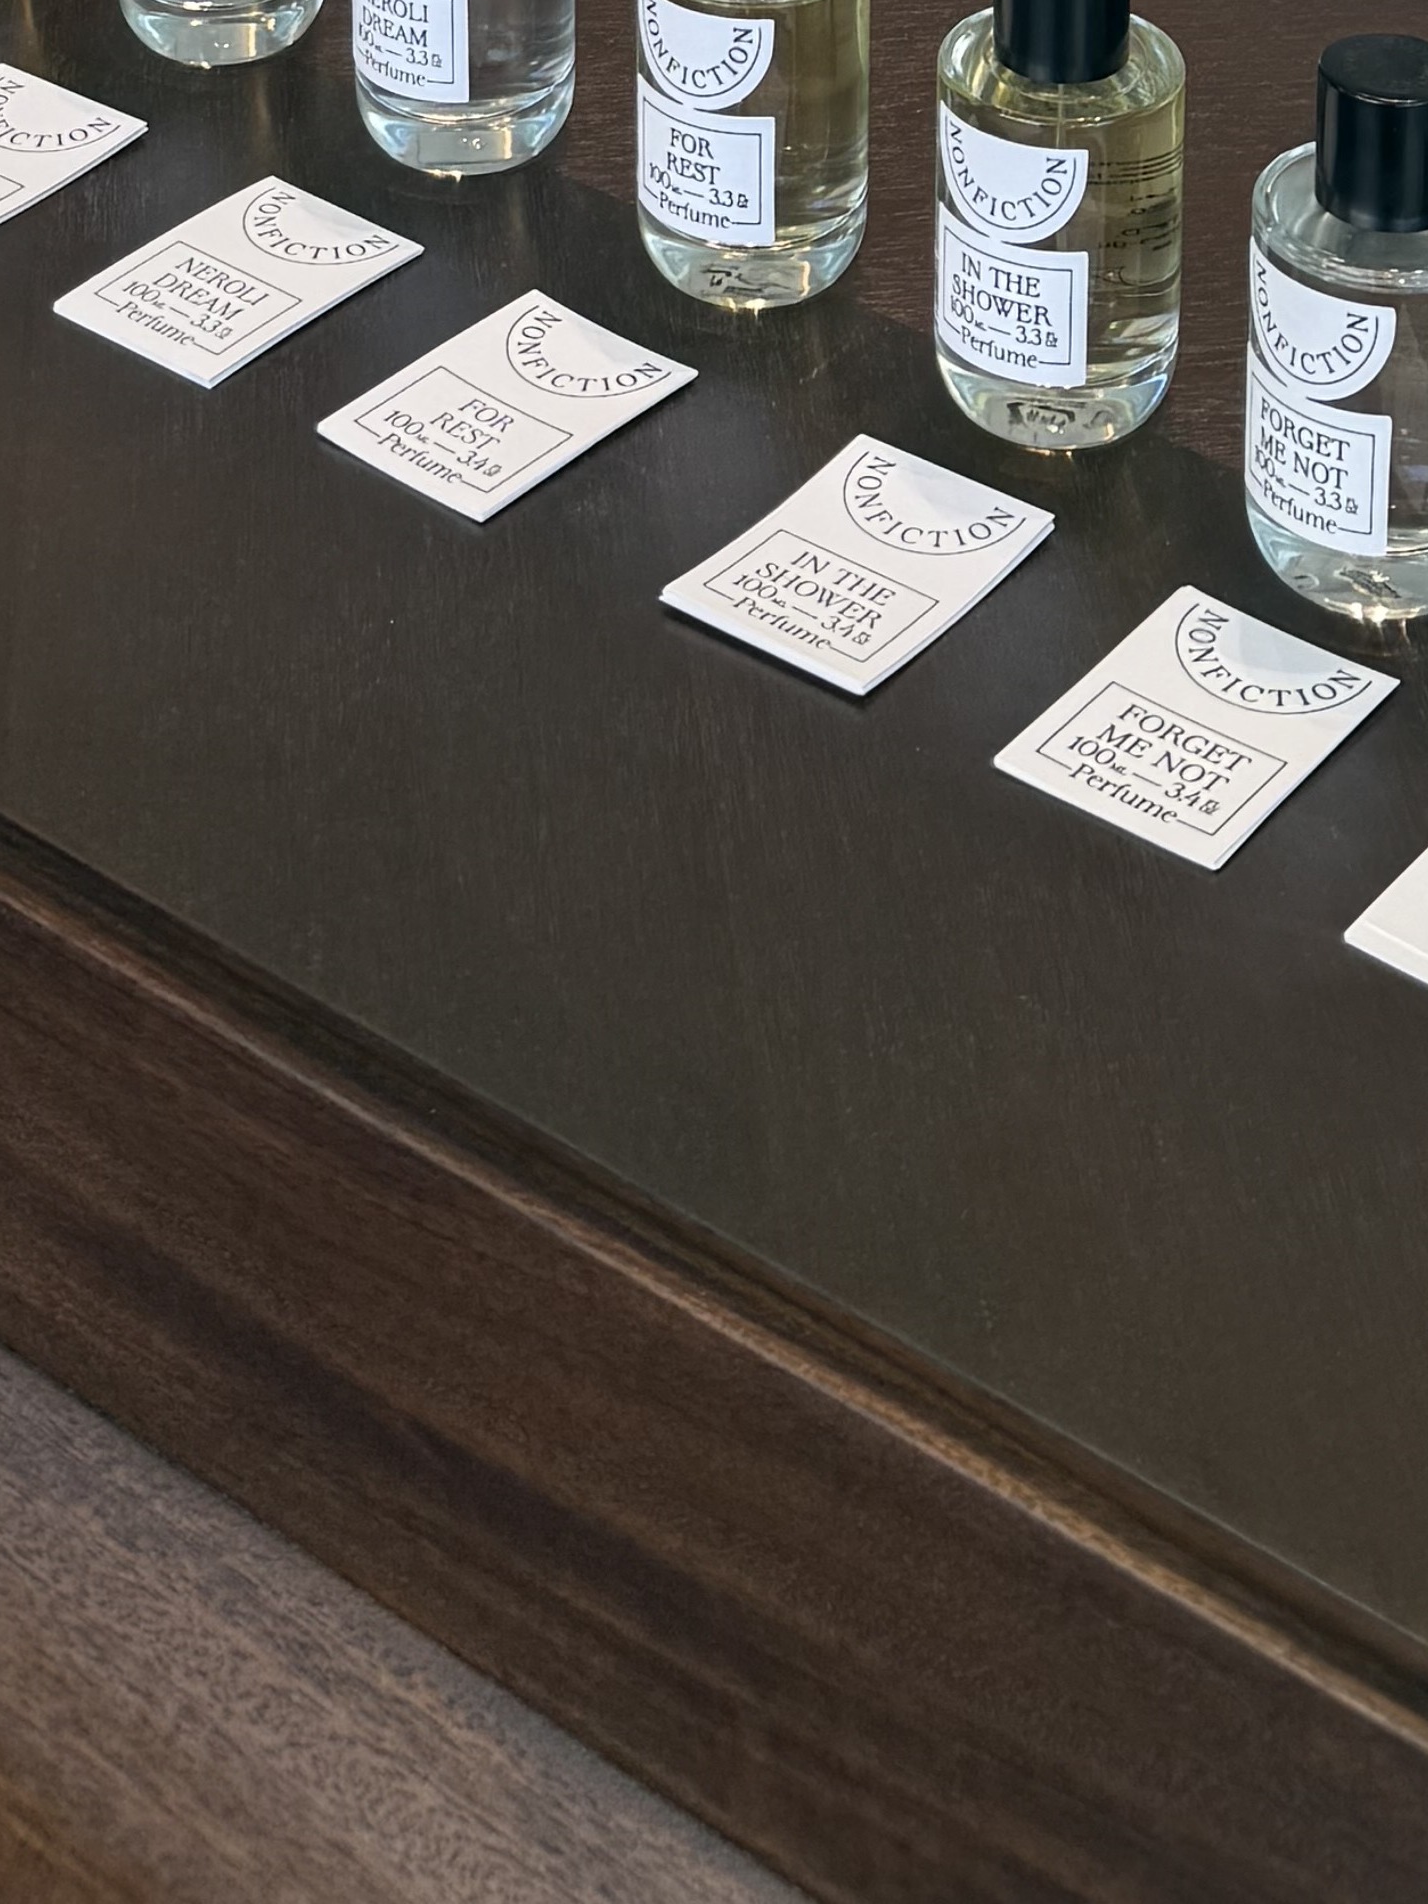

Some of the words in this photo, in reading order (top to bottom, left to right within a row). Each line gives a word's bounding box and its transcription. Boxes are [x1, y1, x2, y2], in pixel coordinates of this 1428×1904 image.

[362, 6, 428, 48] DREAM
[666, 152, 721, 185] REST
[670, 127, 714, 160] FOR
[950, 121, 1067, 221] NONFICTION
[253, 190, 390, 260] NONFICTION
[659, 191, 731, 229] Perfume
[151, 272, 244, 321] DREAM
[175, 256, 270, 306] NEROLI
[952, 273, 1052, 327] SHOWER
[962, 251, 981, 280] IN
[989, 266, 1041, 297] THE
[115, 300, 196, 347] Perfume
[1015, 325, 1043, 346] 3.3
[1256, 259, 1368, 375] NONFICTION
[517, 310, 663, 392] NONFICTION
[961, 325, 1038, 369] Perfume
[430, 411, 501, 449] REST
[457, 397, 514, 433] FOR
[1261, 396, 1350, 461] FORGET
[377, 433, 463, 484] Perfume
[1261, 426, 1286, 466] ME
[1293, 452, 1348, 490] NOT
[855, 455, 1015, 548] NONFICTION
[1263, 479, 1338, 533] Perfume
[756, 561, 884, 630] SHOWER
[790, 551, 830, 575] IN
[830, 567, 896, 607] THE
[733, 595, 831, 650] Perfume
[1188, 608, 1362, 707] NONFICTION
[1095, 723, 1153, 759] ME
[1152, 752, 1231, 794] NOT
[1116, 704, 1253, 772] FORGET
[1069, 761, 1179, 824] Perfume
